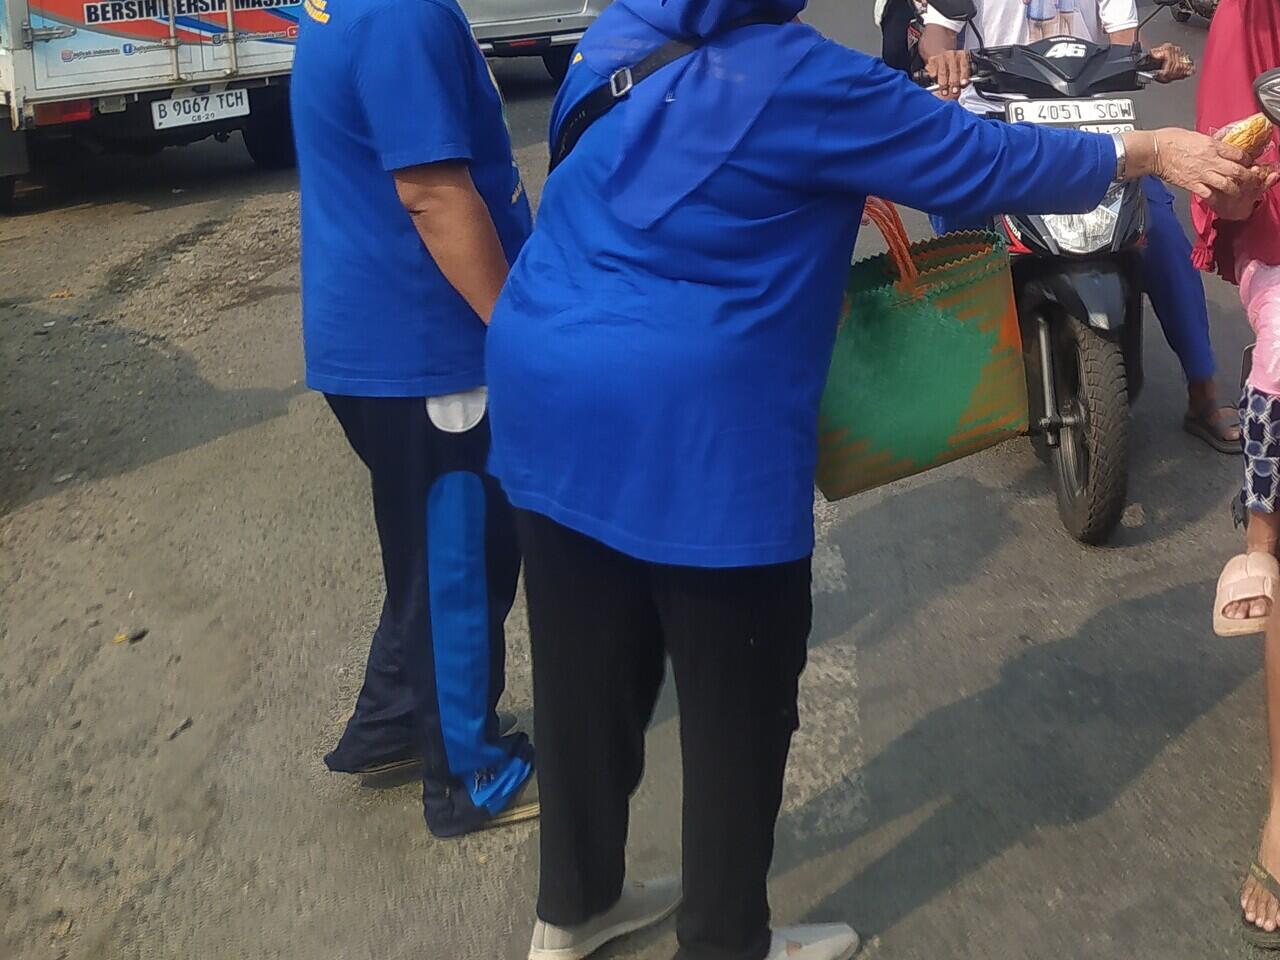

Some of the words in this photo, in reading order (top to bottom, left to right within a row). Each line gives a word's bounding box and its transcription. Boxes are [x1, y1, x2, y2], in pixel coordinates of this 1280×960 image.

[1044, 42, 1087, 58] 46
[158, 103, 168, 119] B
[172, 96, 209, 116] 9067
[216, 91, 244, 109] TCH
[1014, 106, 1024, 121] B
[1038, 104, 1082, 120] 4051
[1095, 102, 1132, 119] SGW
